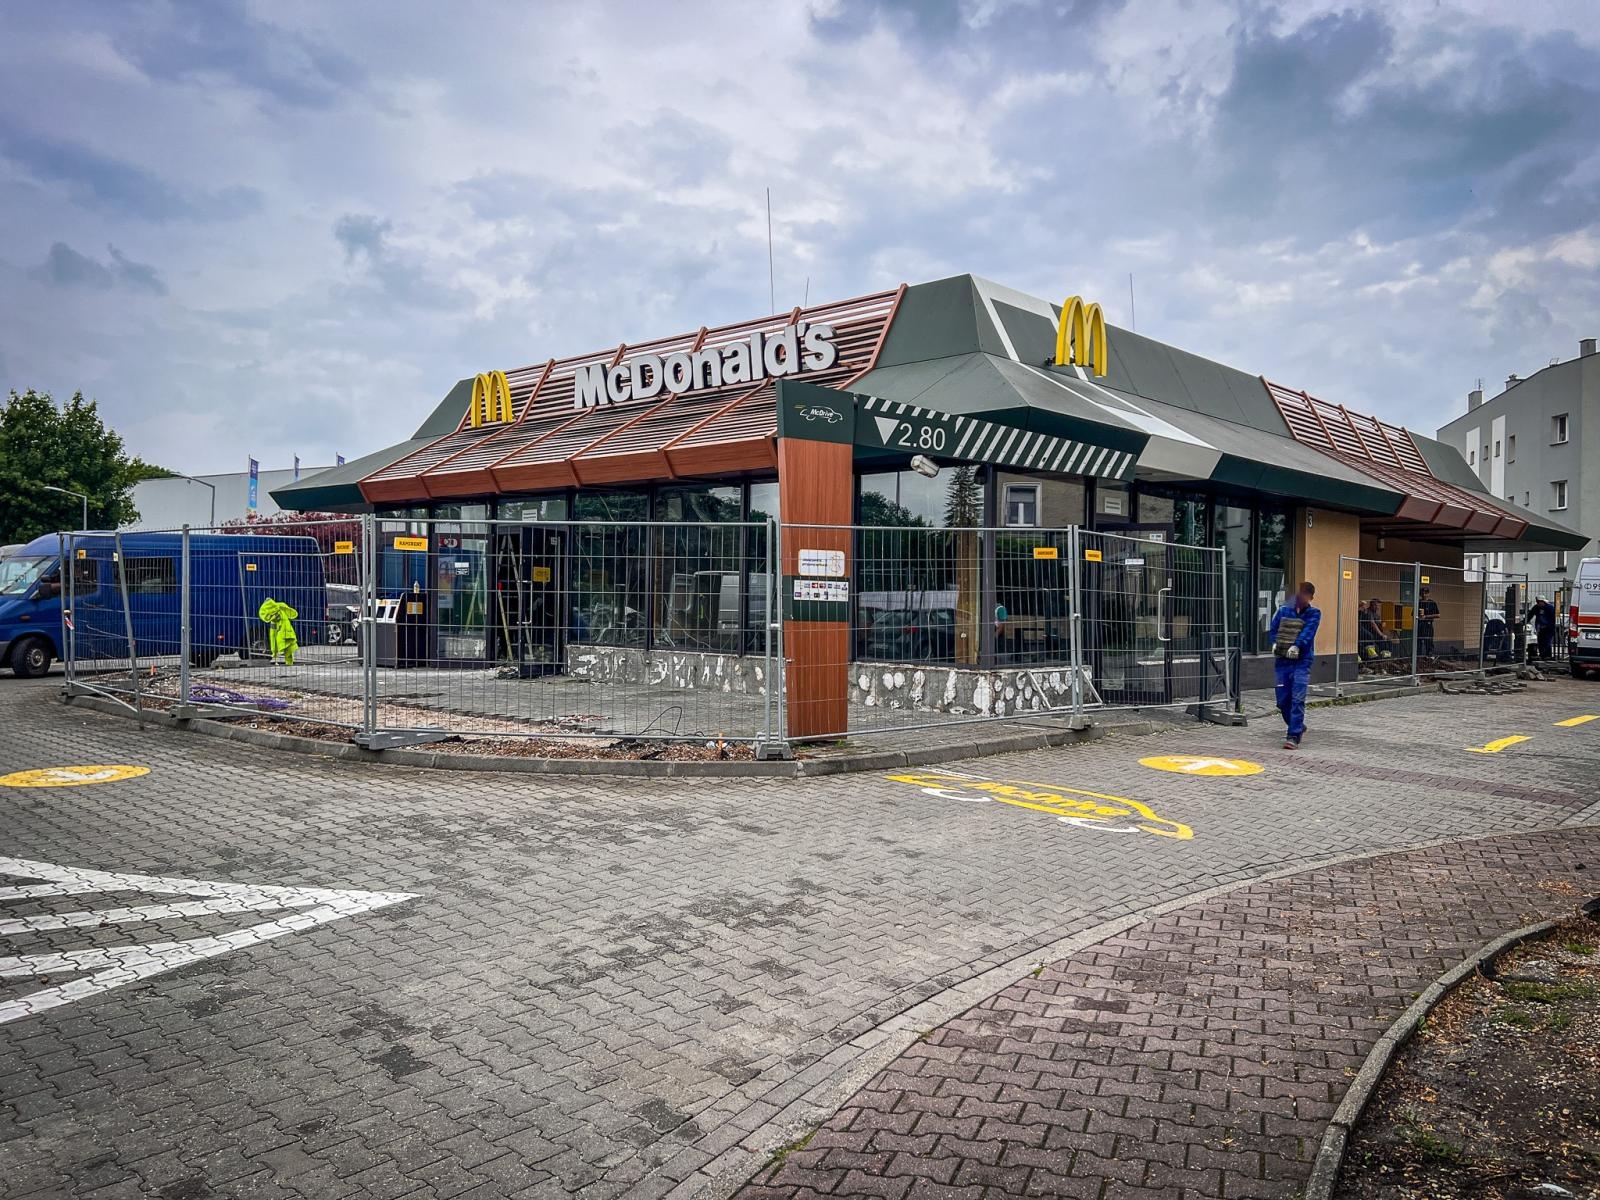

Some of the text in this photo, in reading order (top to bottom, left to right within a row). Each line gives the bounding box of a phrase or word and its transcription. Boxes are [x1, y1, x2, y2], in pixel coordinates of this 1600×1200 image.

[574, 323, 839, 409] McDonald's
[810, 408, 834, 418] McDrive
[898, 422, 946, 451] 2.80
